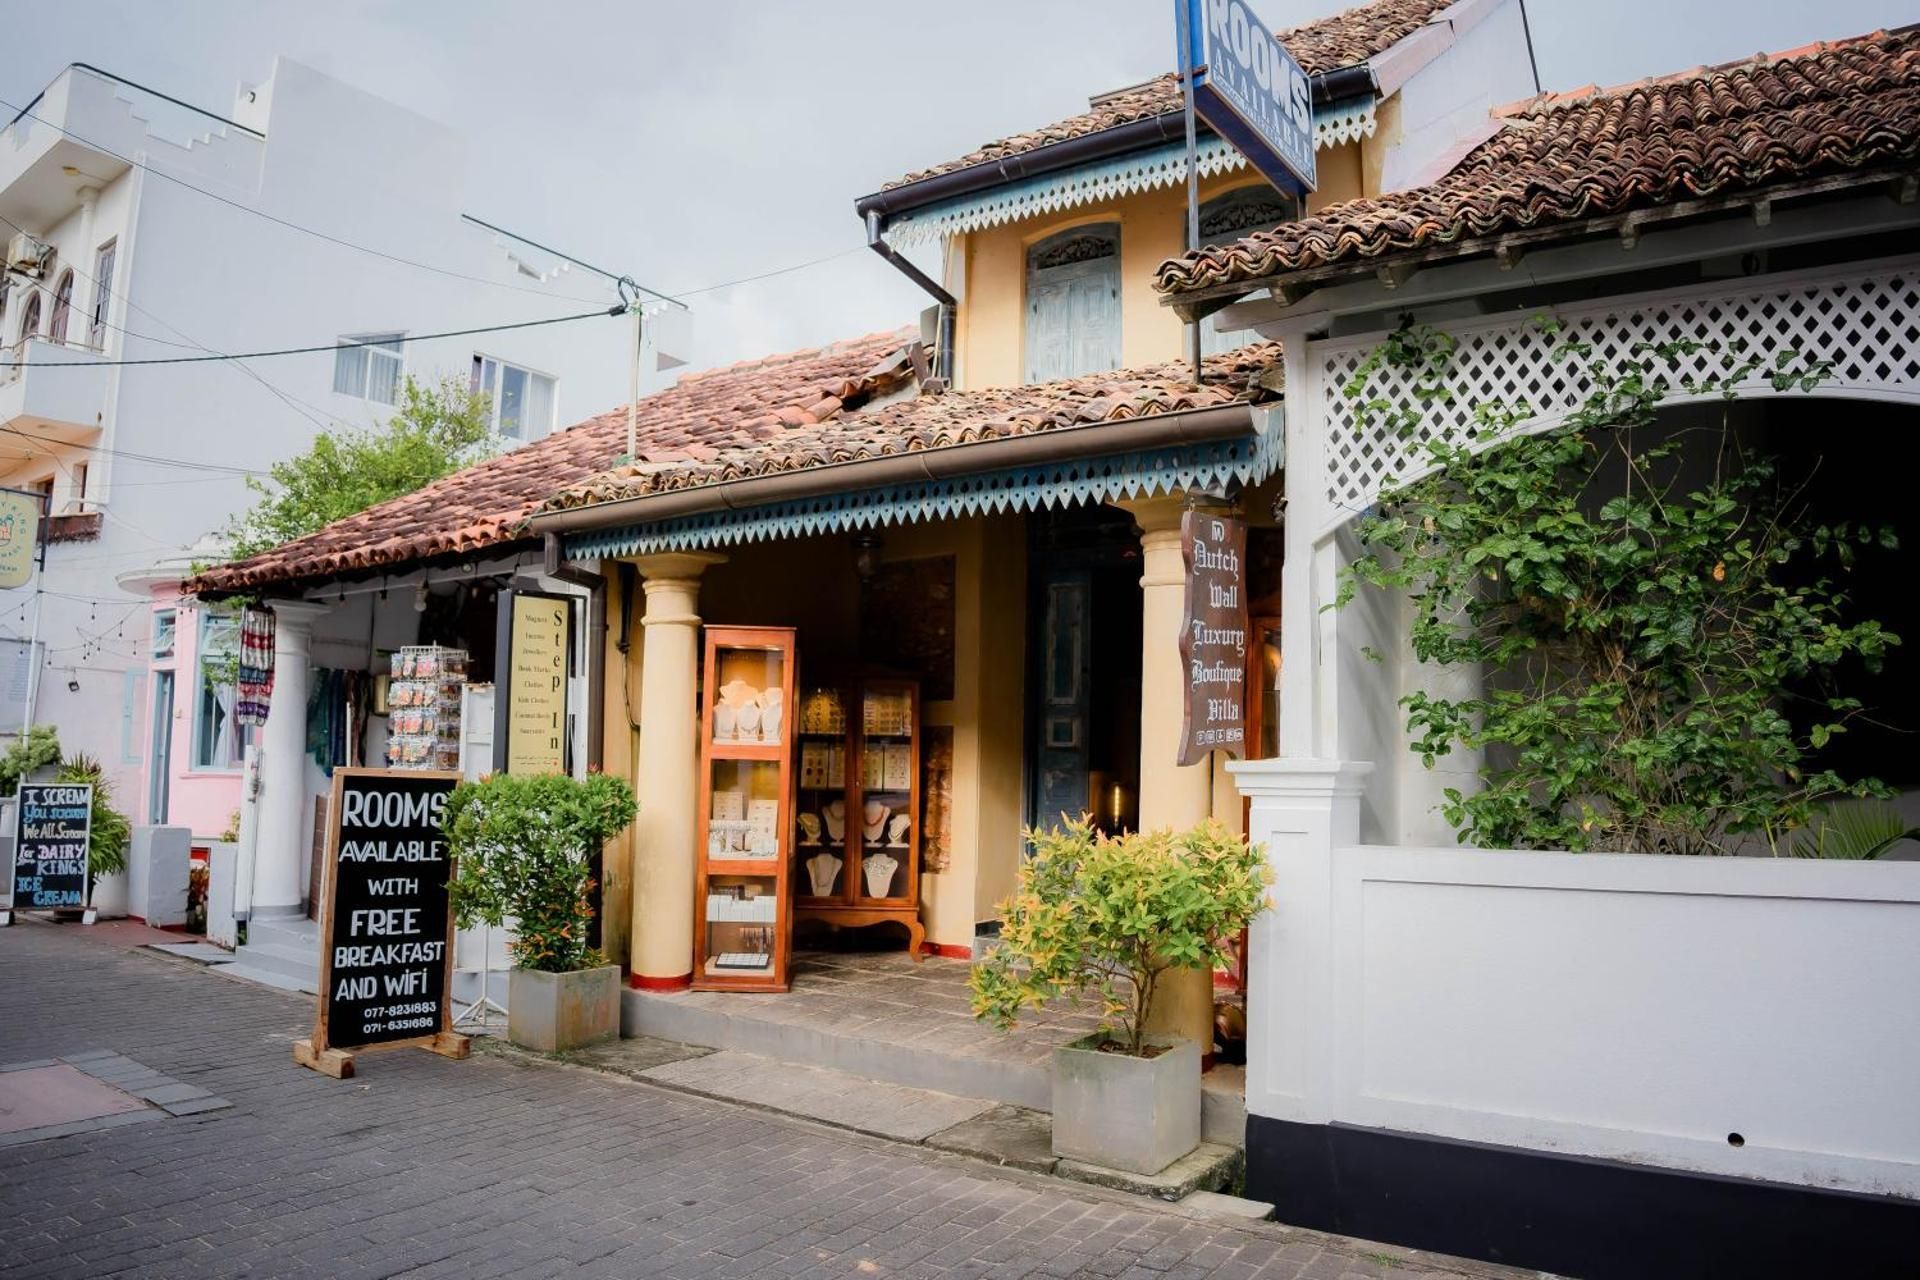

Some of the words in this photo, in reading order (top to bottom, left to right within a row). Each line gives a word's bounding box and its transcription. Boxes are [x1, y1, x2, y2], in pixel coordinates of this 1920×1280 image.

[1209, 0, 1310, 135] ROOMS
[1193, 536, 1239, 581] Dutch
[1209, 578, 1238, 608] Wall
[1192, 619, 1245, 657] Luxury
[1192, 659, 1242, 692] Boutique
[1206, 698, 1239, 725] Villa
[24, 789, 38, 805] I
[342, 790, 449, 828] ROOMS
[23, 823, 39, 840] We
[38, 843, 85, 860] DAIRY
[338, 840, 443, 862] AVAILABLE
[37, 860, 85, 875] KINGS
[16, 876, 43, 892] ICE
[367, 878, 419, 896] WITH
[33, 890, 81, 906] CREAM
[350, 908, 422, 937] FREE
[334, 941, 445, 969] BREAKFAST
[335, 976, 378, 1002] AND
[364, 1001, 437, 1018] 077-8231883
